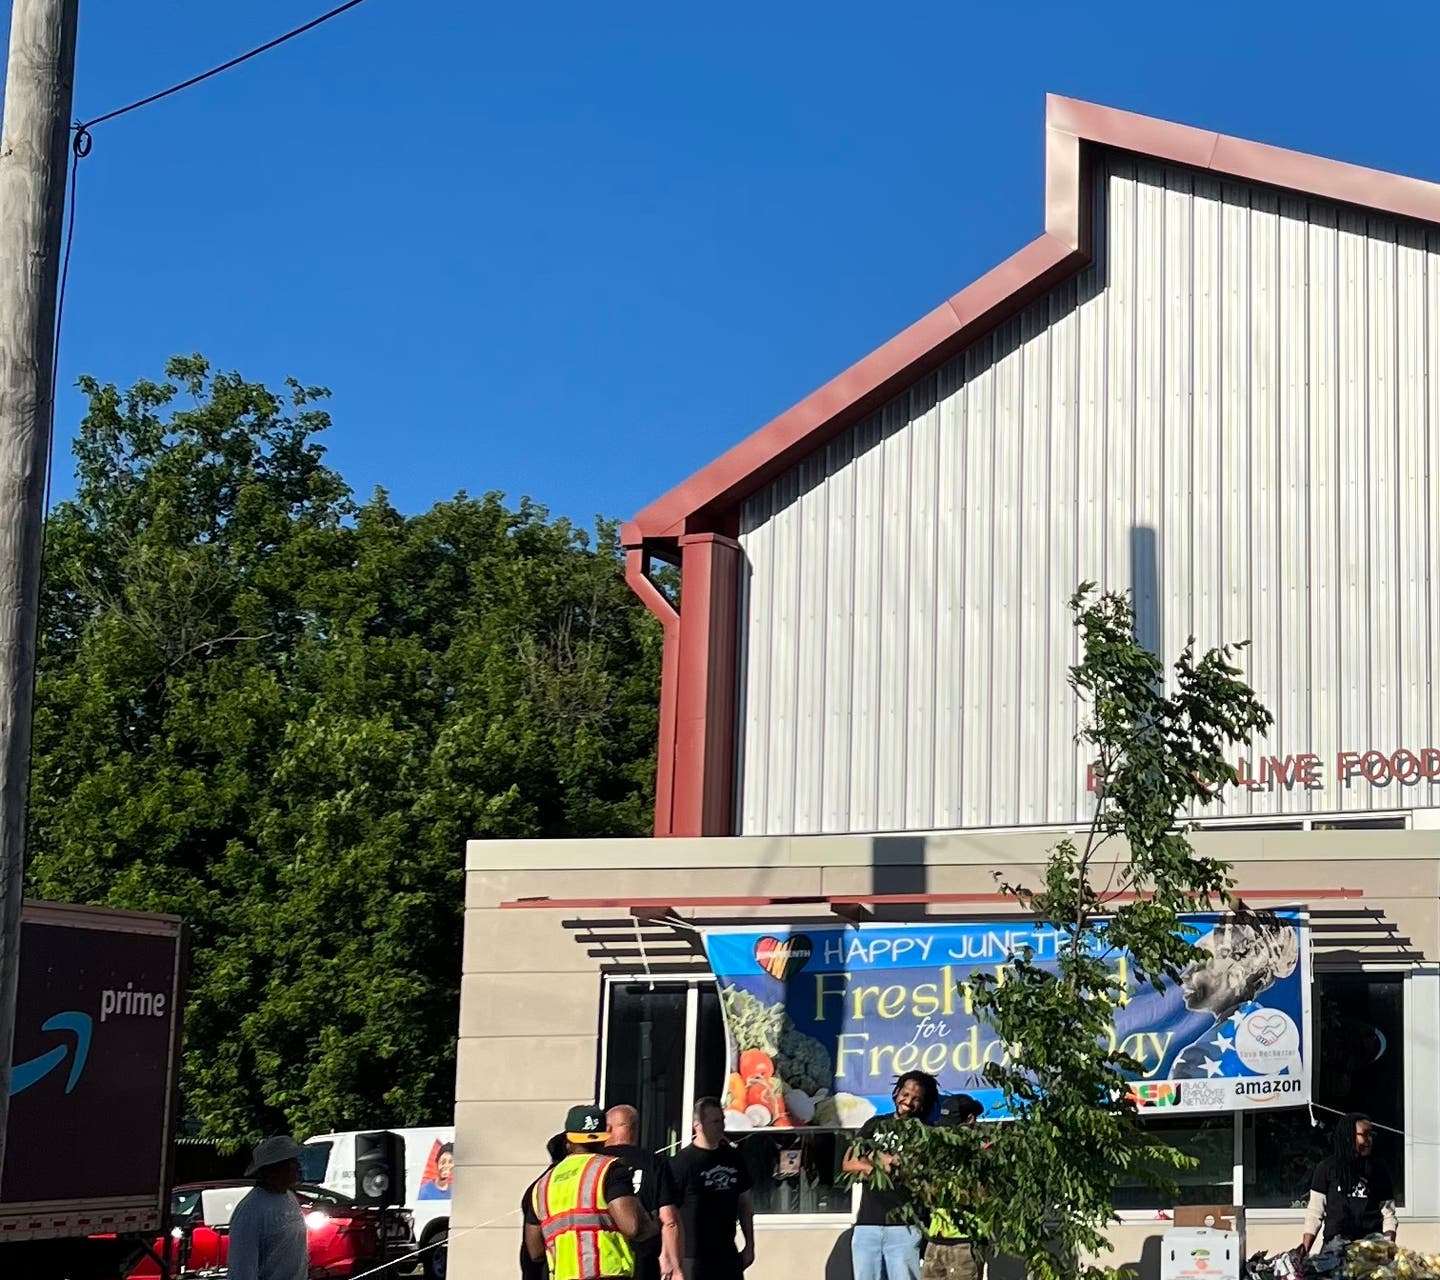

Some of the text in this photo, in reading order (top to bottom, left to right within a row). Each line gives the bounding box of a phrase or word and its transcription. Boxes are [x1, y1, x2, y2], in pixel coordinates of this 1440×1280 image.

[1238, 753, 1318, 786] LIVE
[823, 935, 935, 964] HAPPY
[100, 982, 166, 1022] prime
[813, 965, 974, 1021] Fresh
[907, 1016, 952, 1045] for
[834, 1024, 1022, 1078] Freedo
[1182, 1081, 1209, 1090] BLACK
[1182, 1089, 1225, 1098] EMPLOYEE
[1234, 1079, 1302, 1096] amazon
[1182, 1097, 1225, 1106] NETWORK
